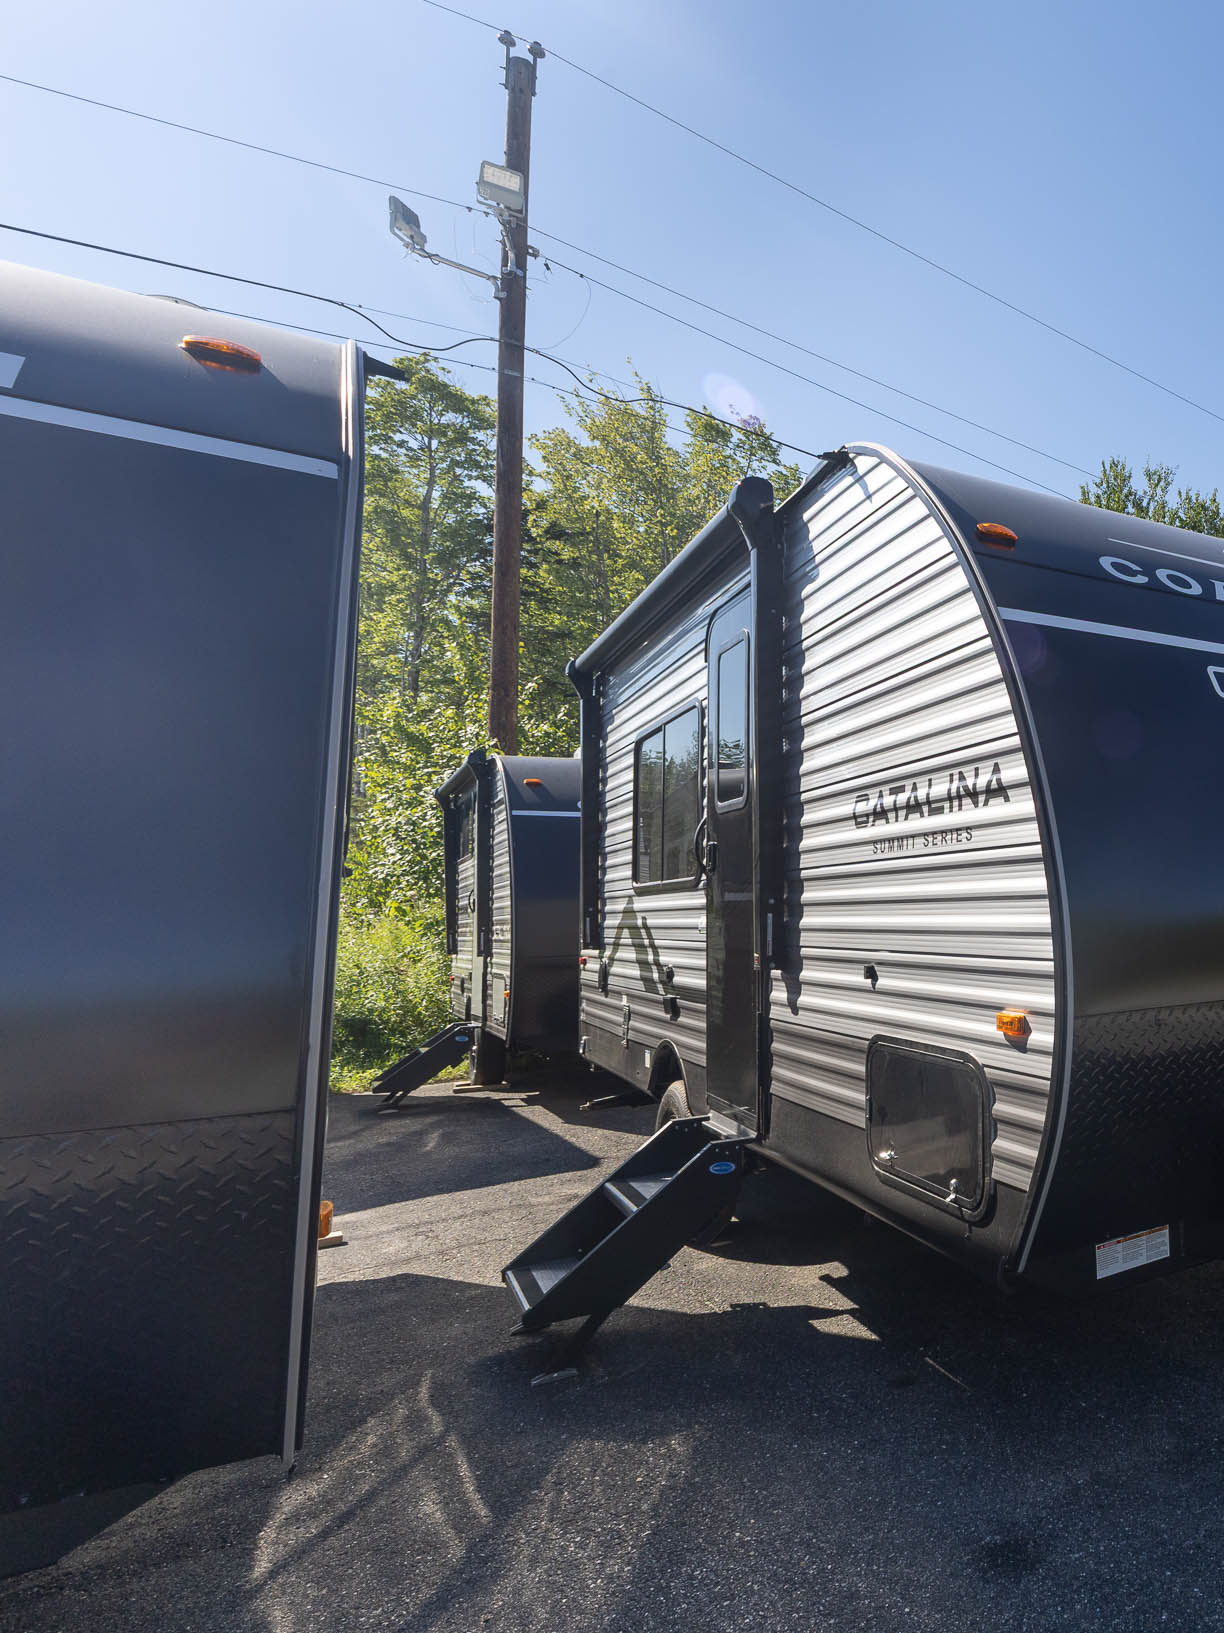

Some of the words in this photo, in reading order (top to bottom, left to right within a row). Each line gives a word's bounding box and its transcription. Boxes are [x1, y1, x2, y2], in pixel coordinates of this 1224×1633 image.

[853, 762, 1011, 829] CATALINA
[872, 835, 916, 855] SUMMIT
[923, 826, 973, 847] SERIES
